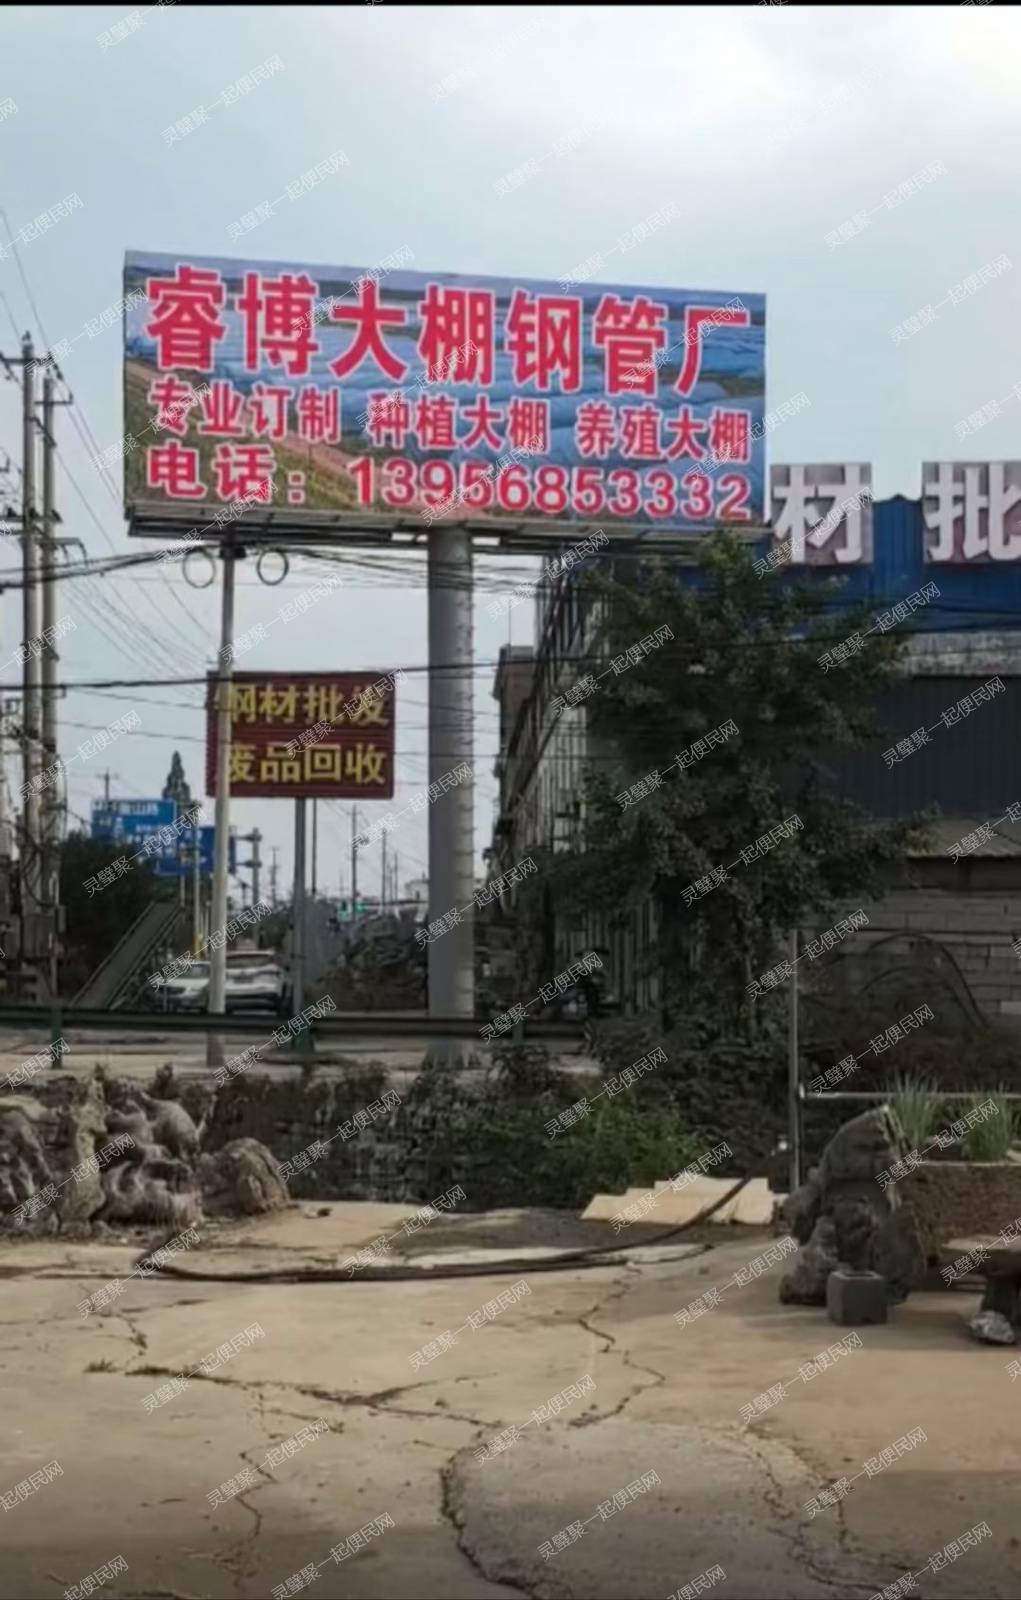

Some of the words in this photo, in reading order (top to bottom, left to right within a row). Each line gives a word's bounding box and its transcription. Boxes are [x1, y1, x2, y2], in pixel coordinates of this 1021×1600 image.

[146, 264, 751, 398] 睿博大棚钢管厂
[148, 374, 342, 443] 专业订制
[367, 392, 551, 456] 种植大棚
[575, 402, 752, 464] 养殖大棚
[346, 456, 752, 521] 13956853332
